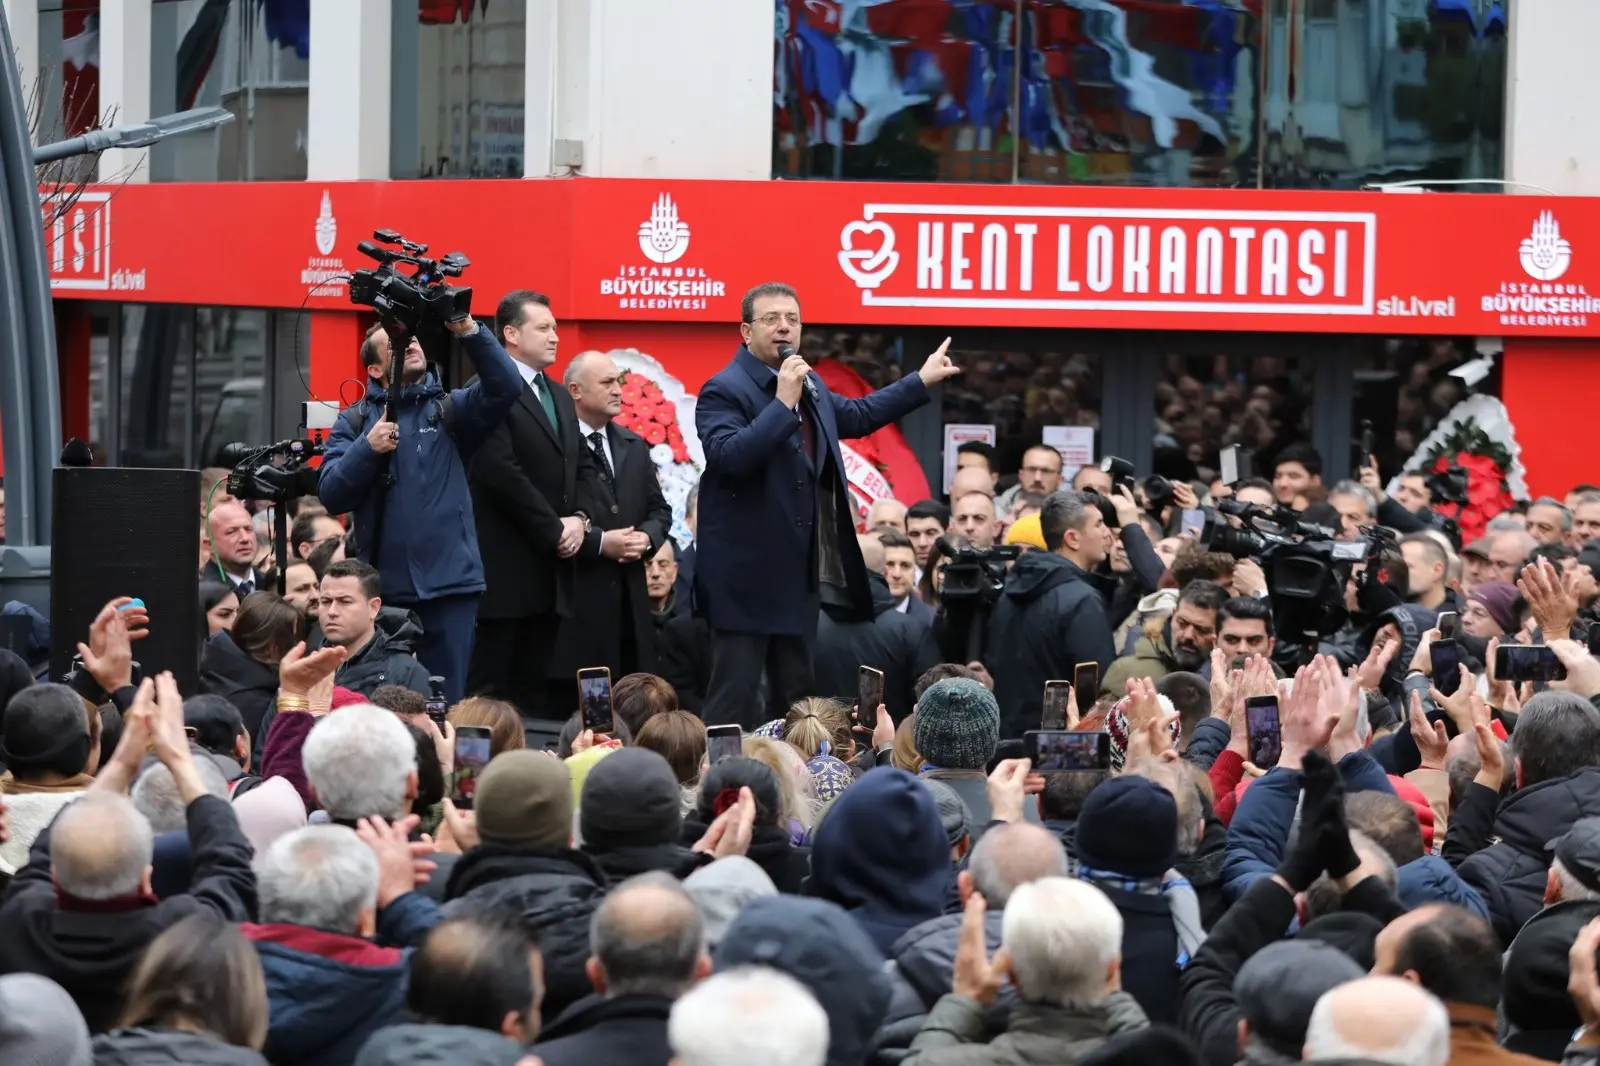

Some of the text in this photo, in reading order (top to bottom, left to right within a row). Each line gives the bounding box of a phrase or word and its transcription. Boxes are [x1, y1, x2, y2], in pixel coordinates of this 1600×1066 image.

[916, 221, 1348, 297] KENT LOKANTASI
[620, 265, 707, 277] İSTANBUL
[600, 277, 726, 297] BÜYÜKŞEHİR
[1500, 281, 1587, 294] İSTANBUL
[619, 298, 707, 310] BELEDİYESİ
[1500, 314, 1587, 326] BELEDİYESİ
